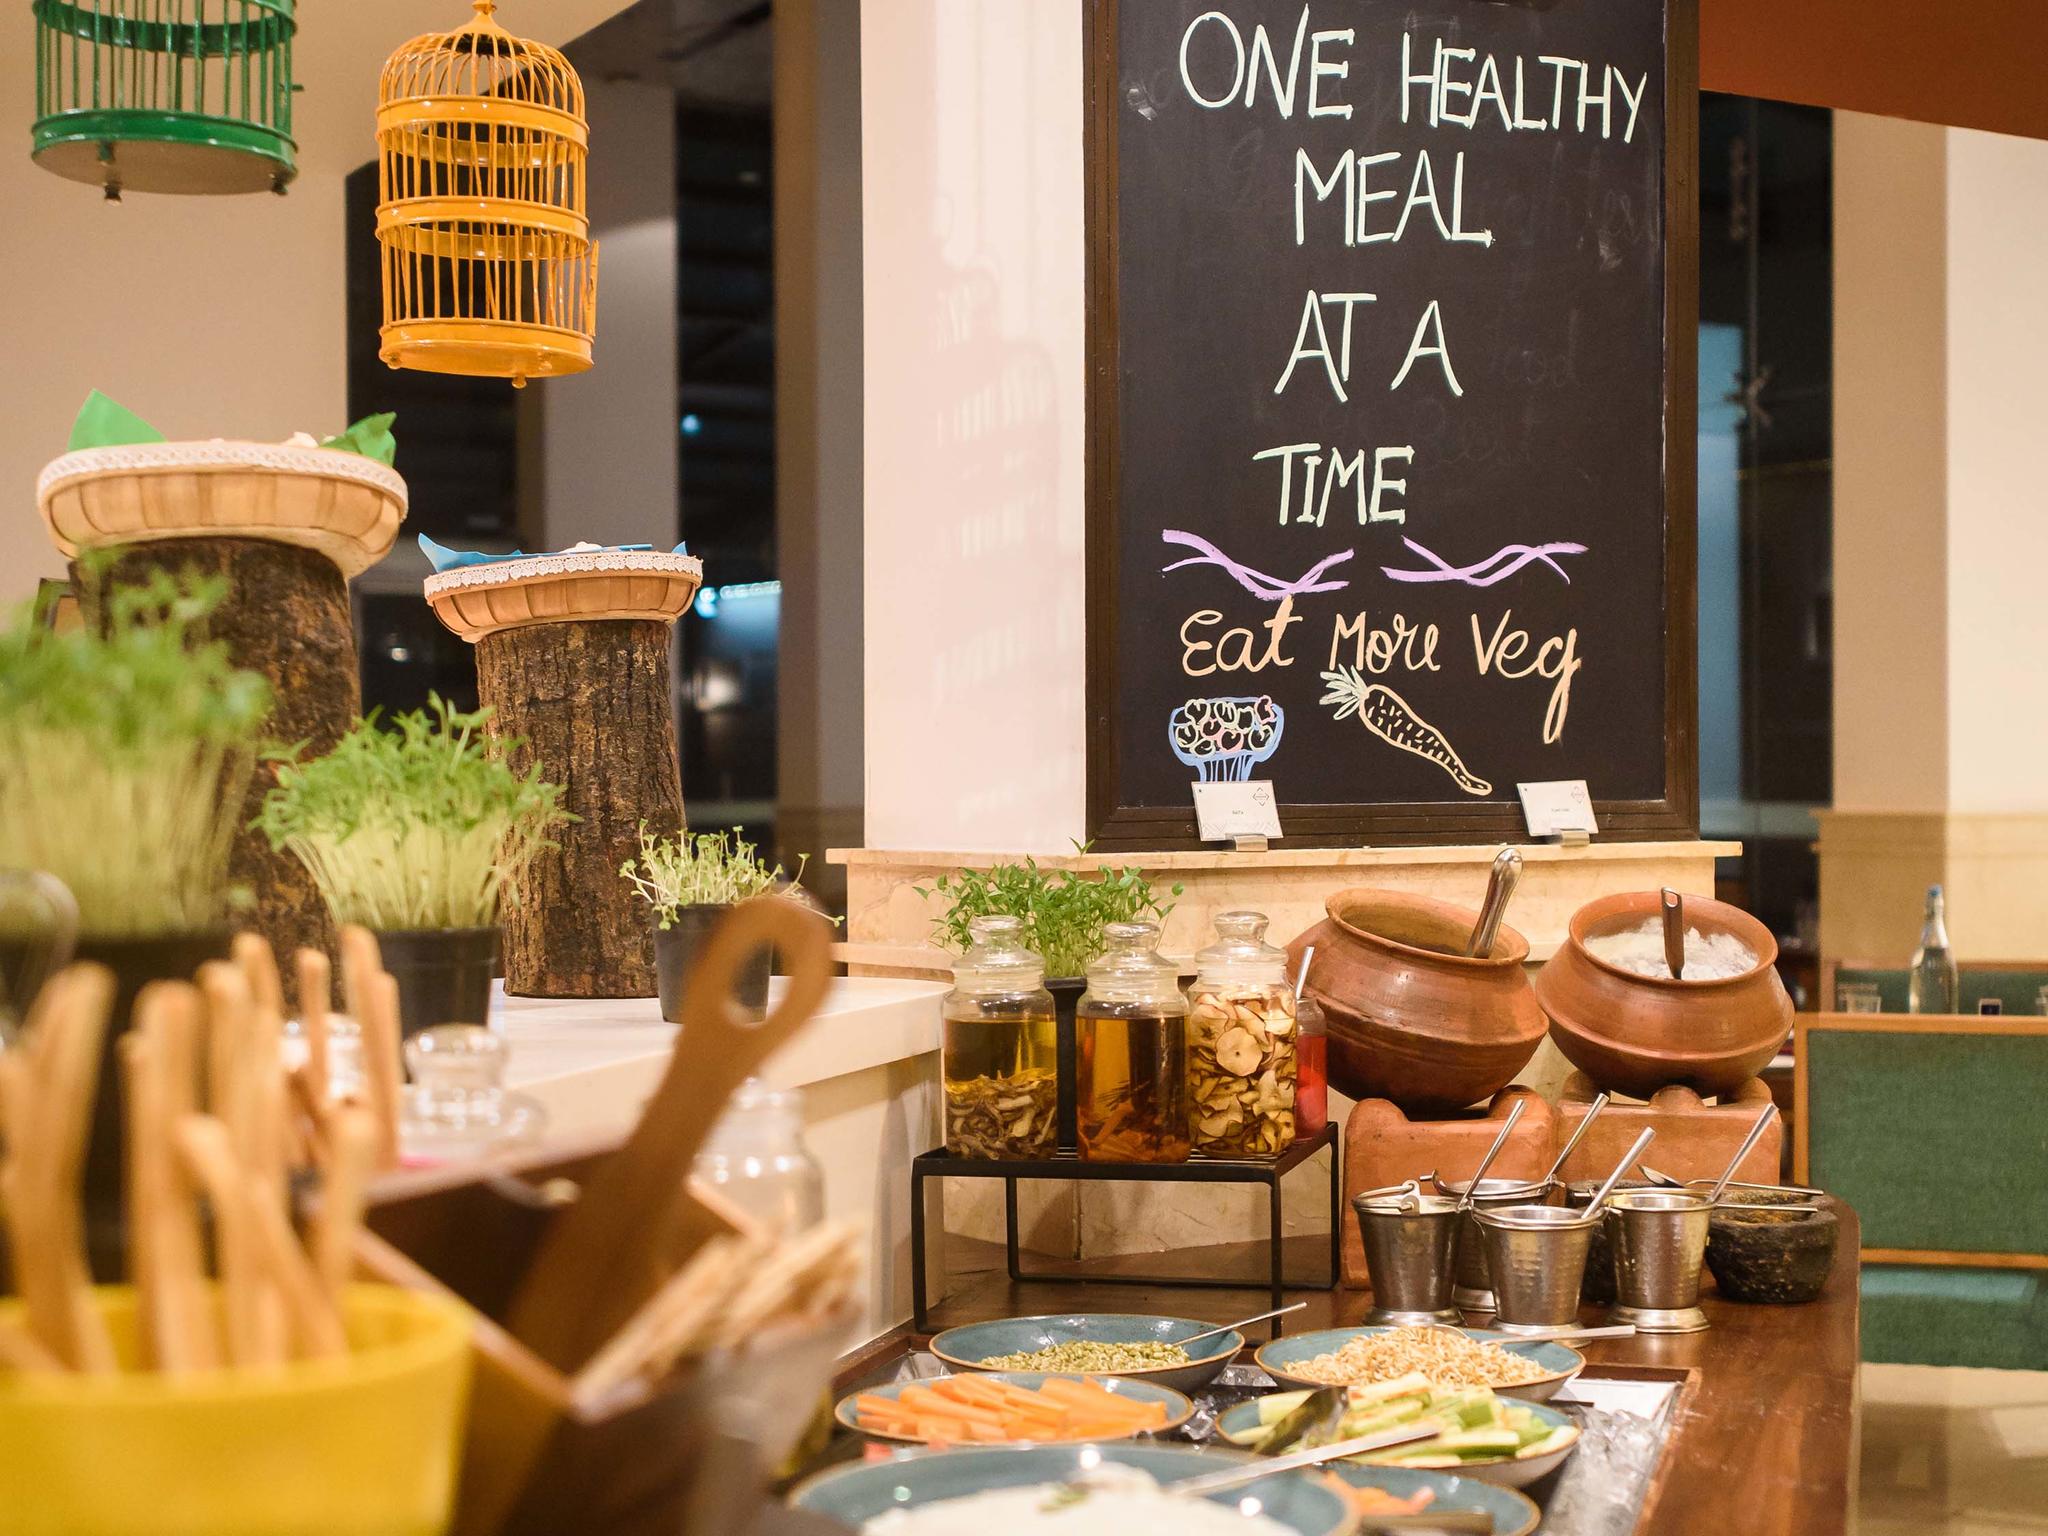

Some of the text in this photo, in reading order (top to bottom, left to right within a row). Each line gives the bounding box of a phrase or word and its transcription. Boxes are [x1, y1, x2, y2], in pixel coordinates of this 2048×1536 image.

[1179, 3, 1648, 144] ONE HEALTHY
[1293, 147, 1493, 249] MEAL
[1273, 289, 1378, 403] AT
[1390, 299, 1464, 397] A
[1252, 442, 1416, 528] TIME
[1180, 595, 1582, 745] Eat More Veg
